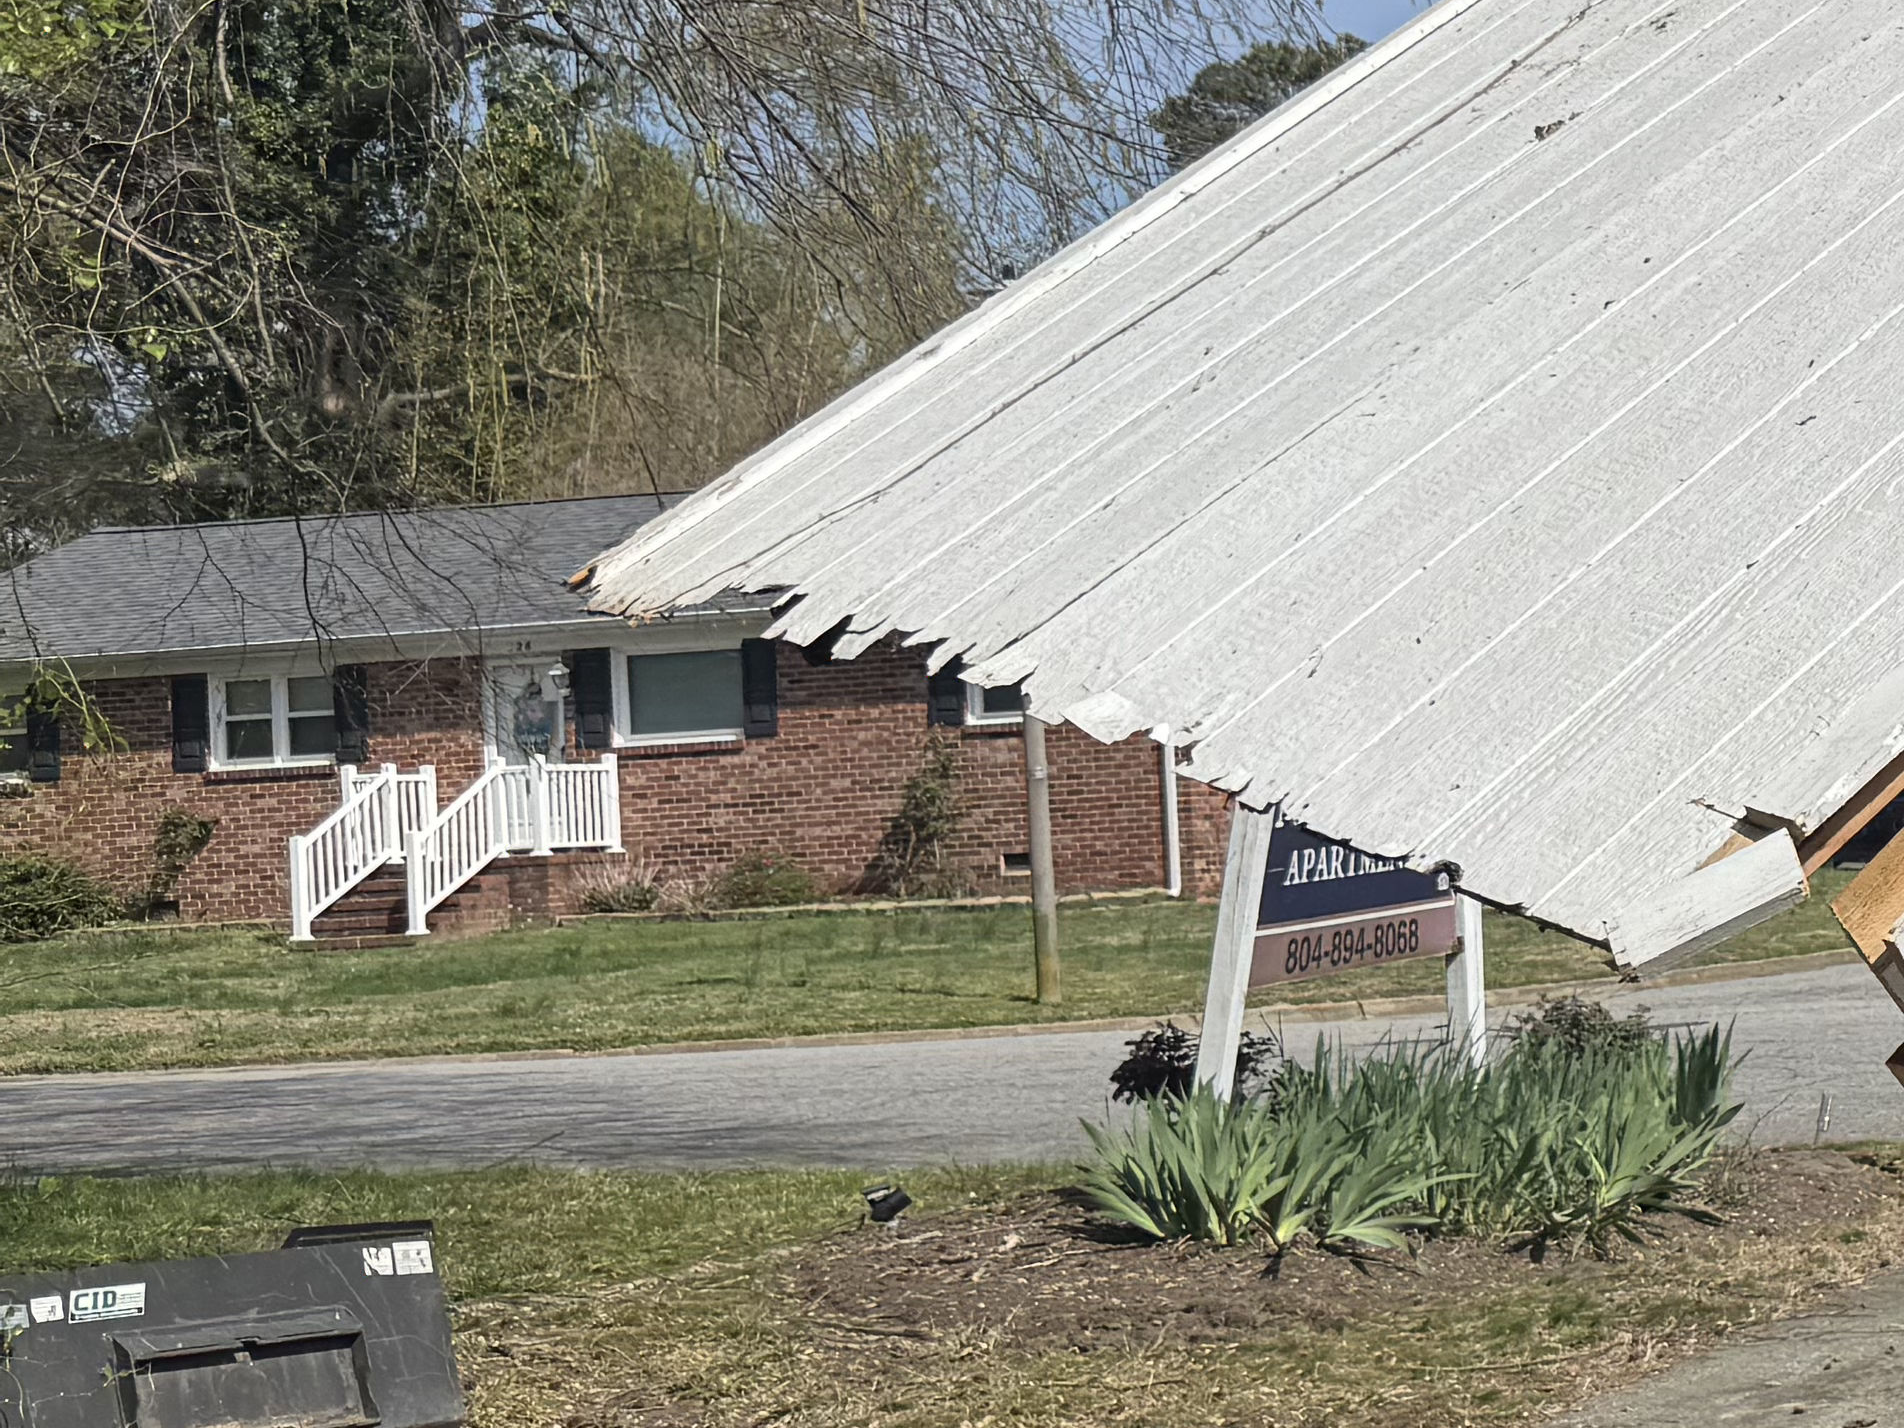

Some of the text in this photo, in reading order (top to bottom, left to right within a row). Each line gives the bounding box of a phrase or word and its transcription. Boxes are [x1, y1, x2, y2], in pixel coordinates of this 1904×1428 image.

[1283, 845, 1405, 887] APART
[1285, 918, 1420, 974] 804-894-8068
[74, 1290, 117, 1311] CID
